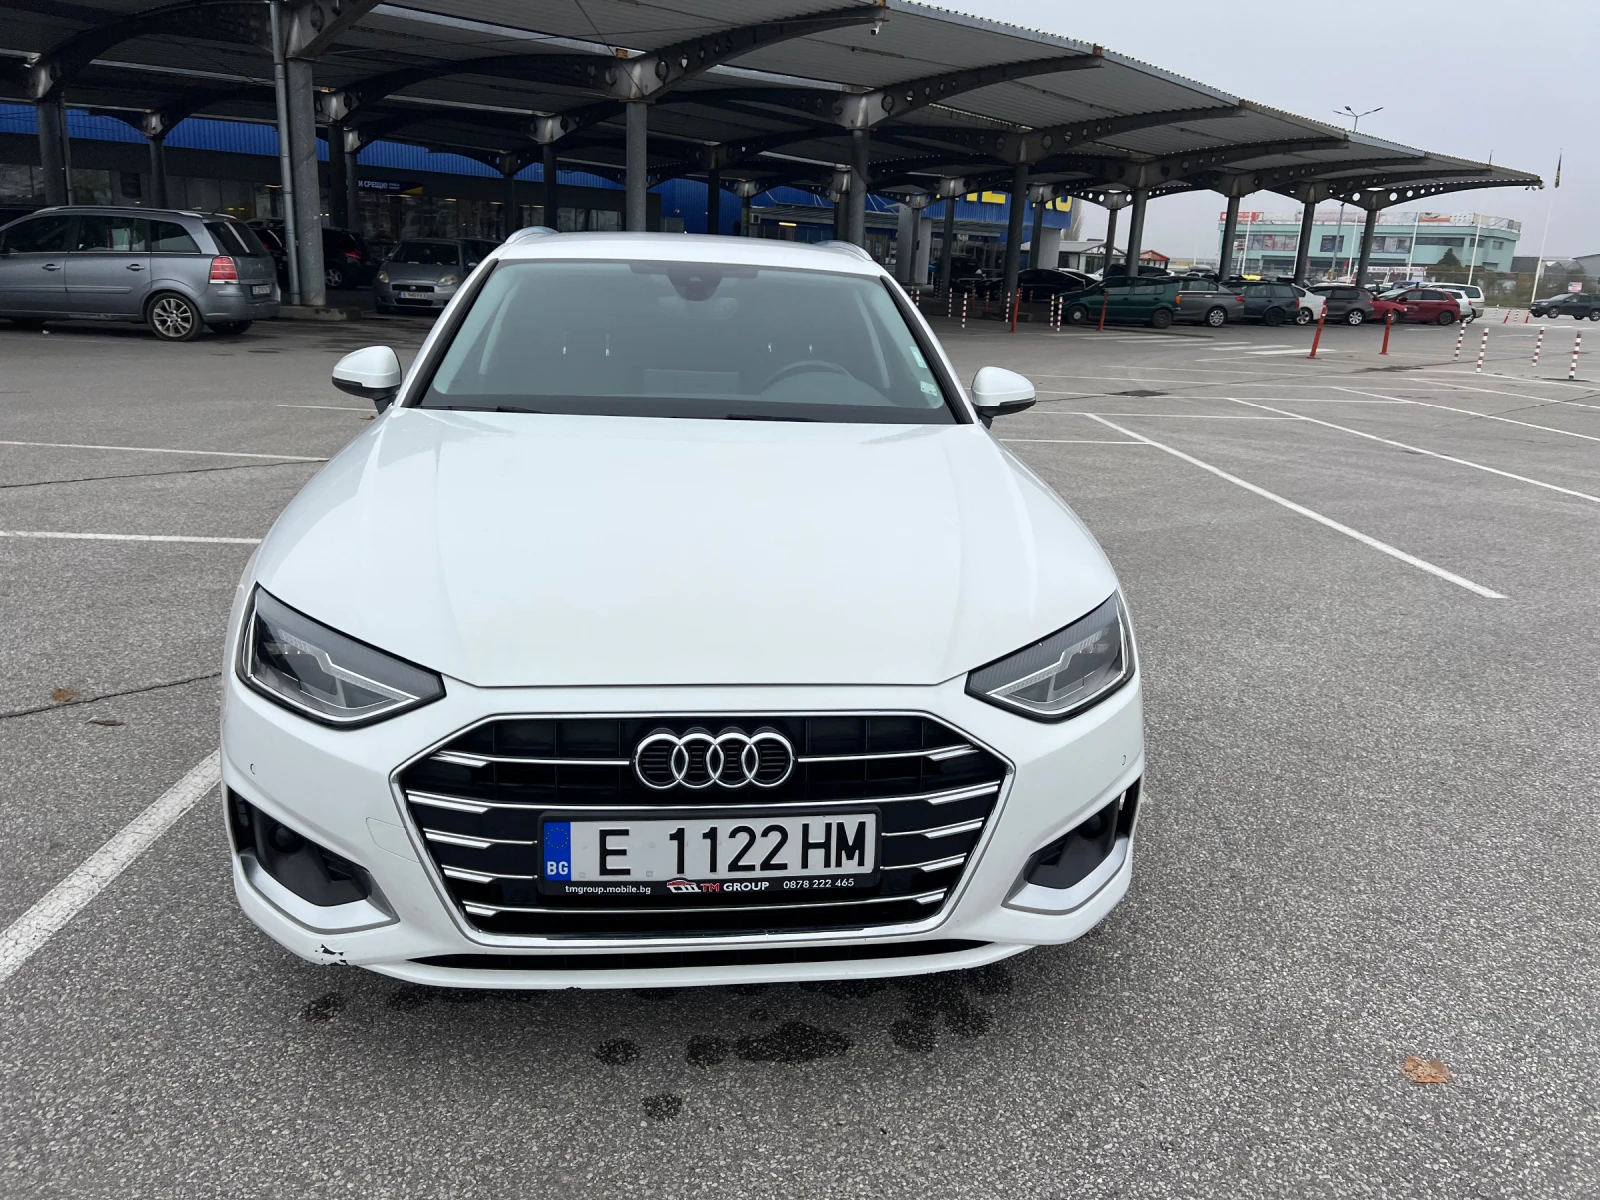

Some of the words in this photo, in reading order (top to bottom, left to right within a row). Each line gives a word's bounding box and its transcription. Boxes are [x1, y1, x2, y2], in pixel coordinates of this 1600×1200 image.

[599, 829, 631, 876] E
[547, 861, 569, 875] BG
[565, 885, 652, 895] tmgroup.mobile.bg
[700, 882, 720, 893] TM
[723, 881, 770, 892] GROUP
[783, 880, 809, 889] 0878
[812, 879, 832, 888] 222
[834, 878, 855, 887] 465
